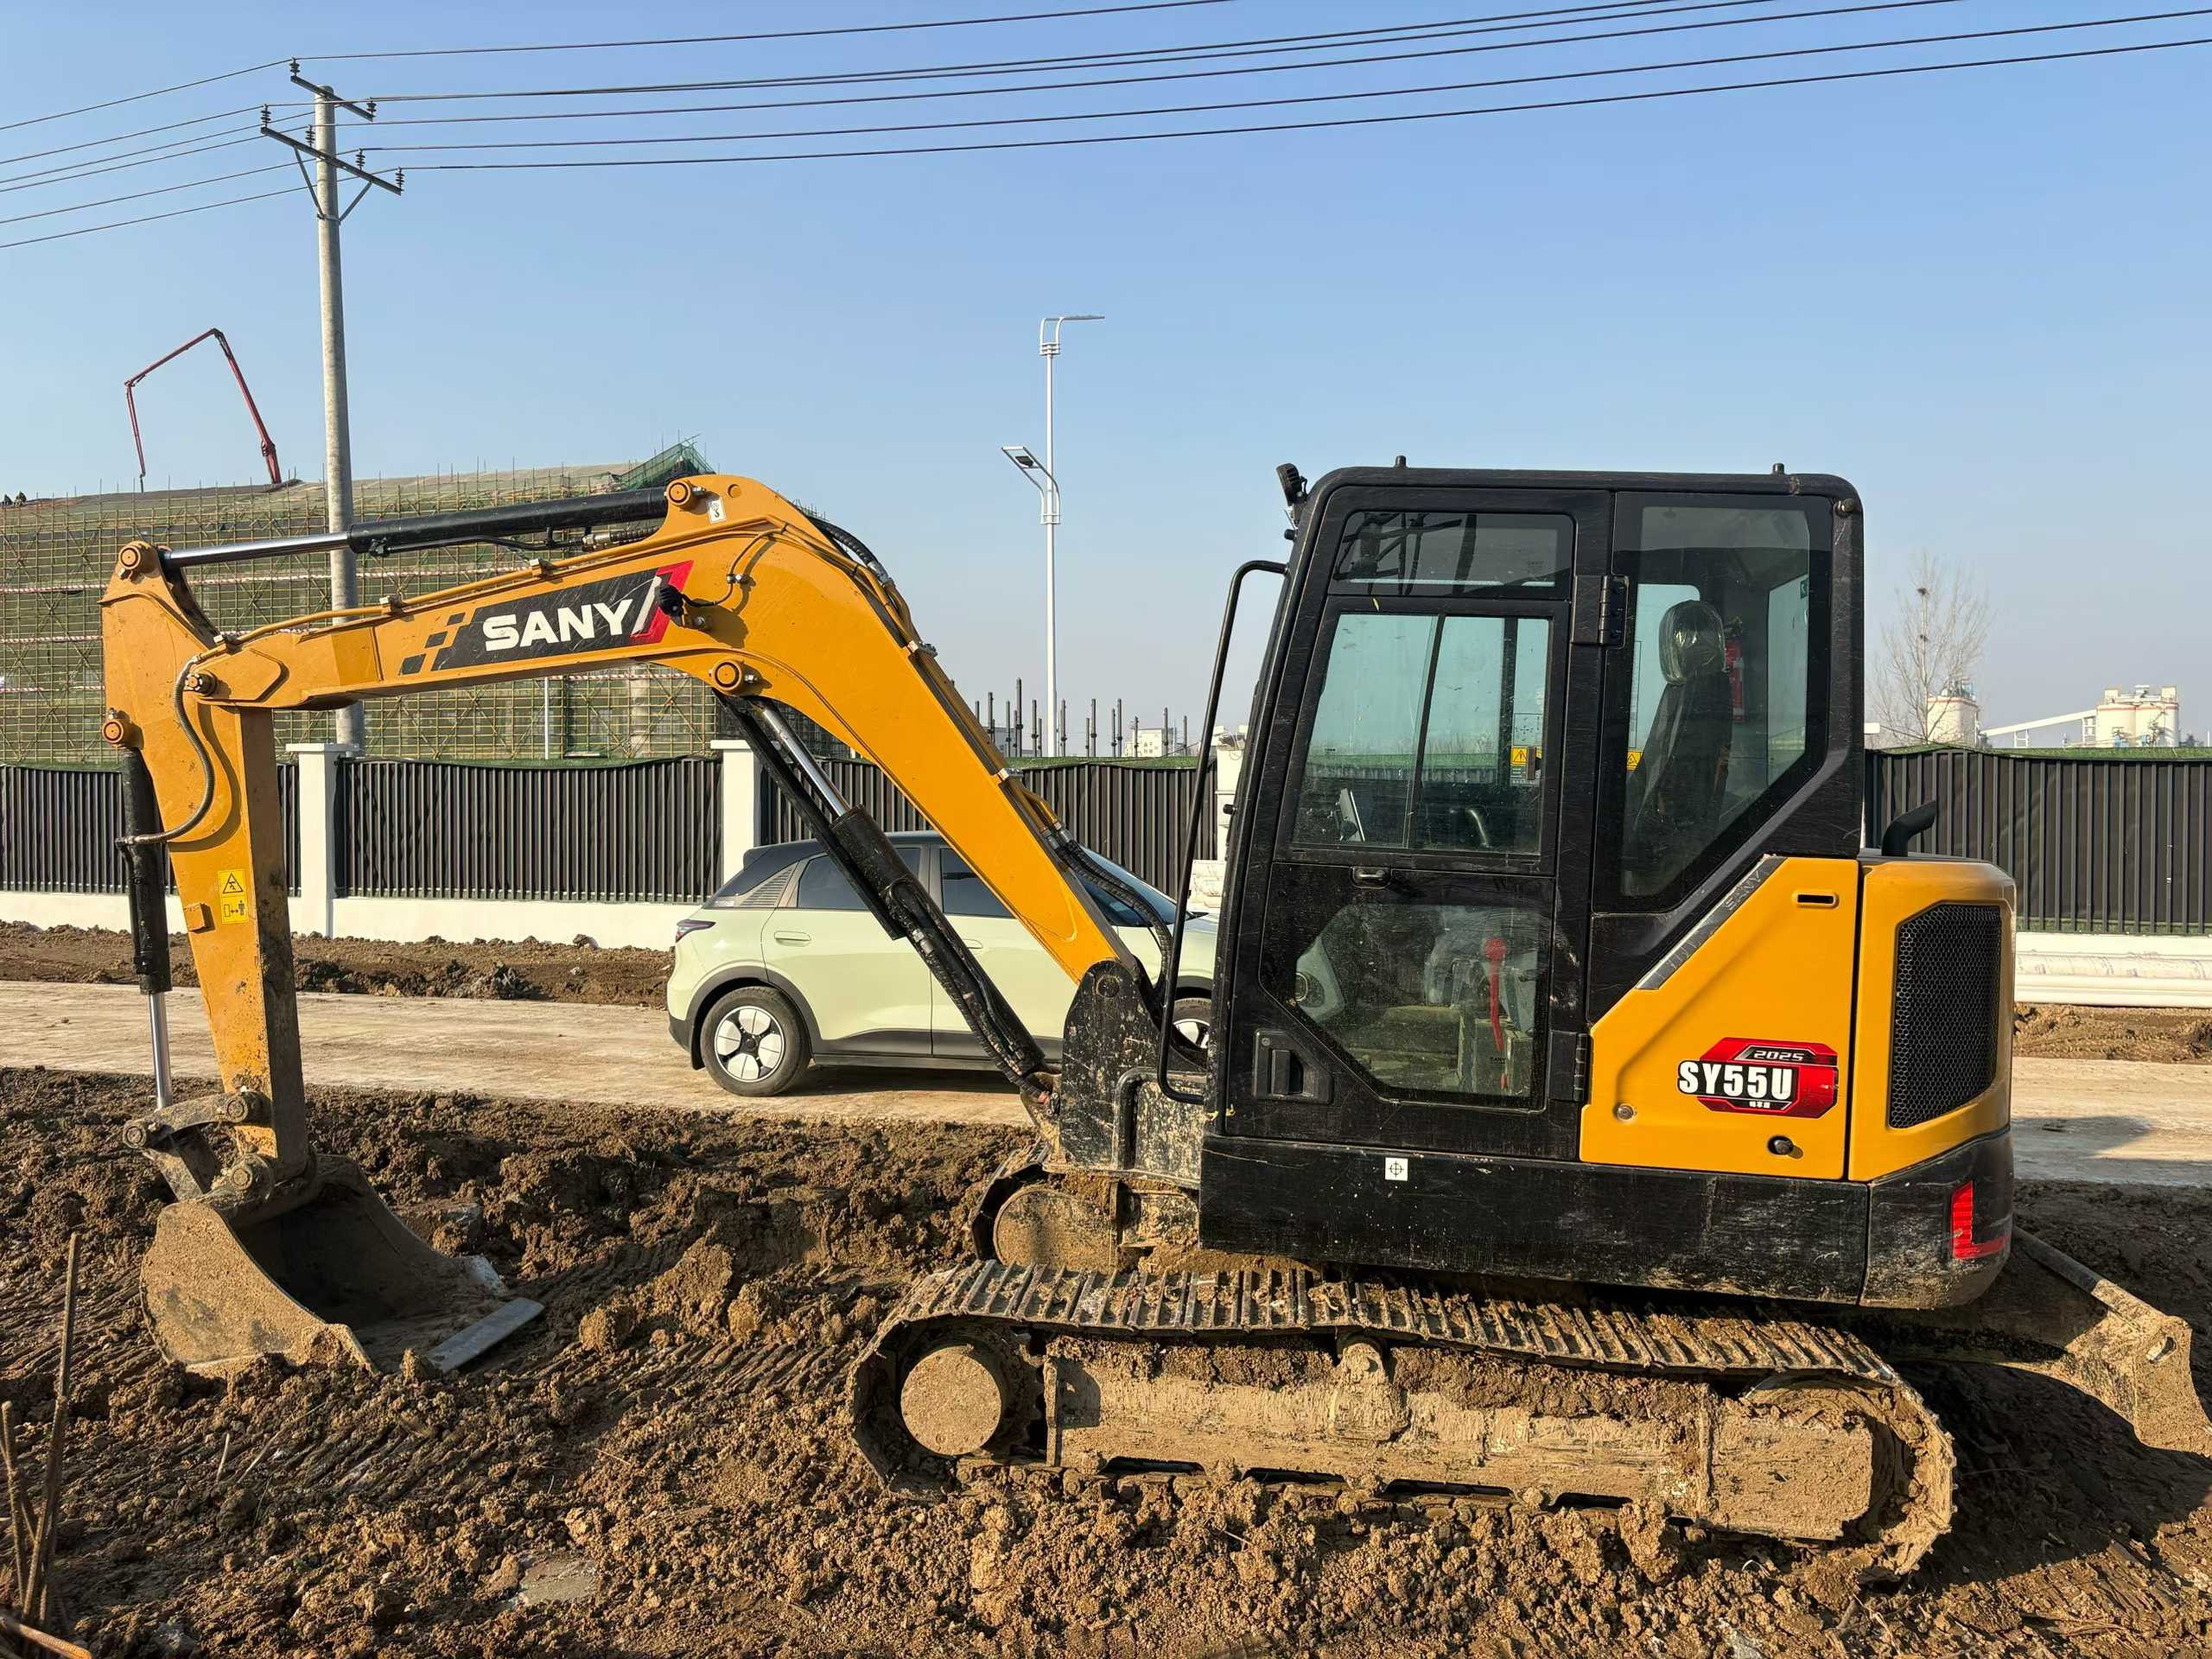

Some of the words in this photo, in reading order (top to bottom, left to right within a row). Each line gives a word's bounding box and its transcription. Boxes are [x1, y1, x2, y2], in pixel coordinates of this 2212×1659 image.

[482, 599, 633, 652] SANY
[1753, 1050, 1805, 1062] 2025
[1679, 1061, 1793, 1100] SY55U
